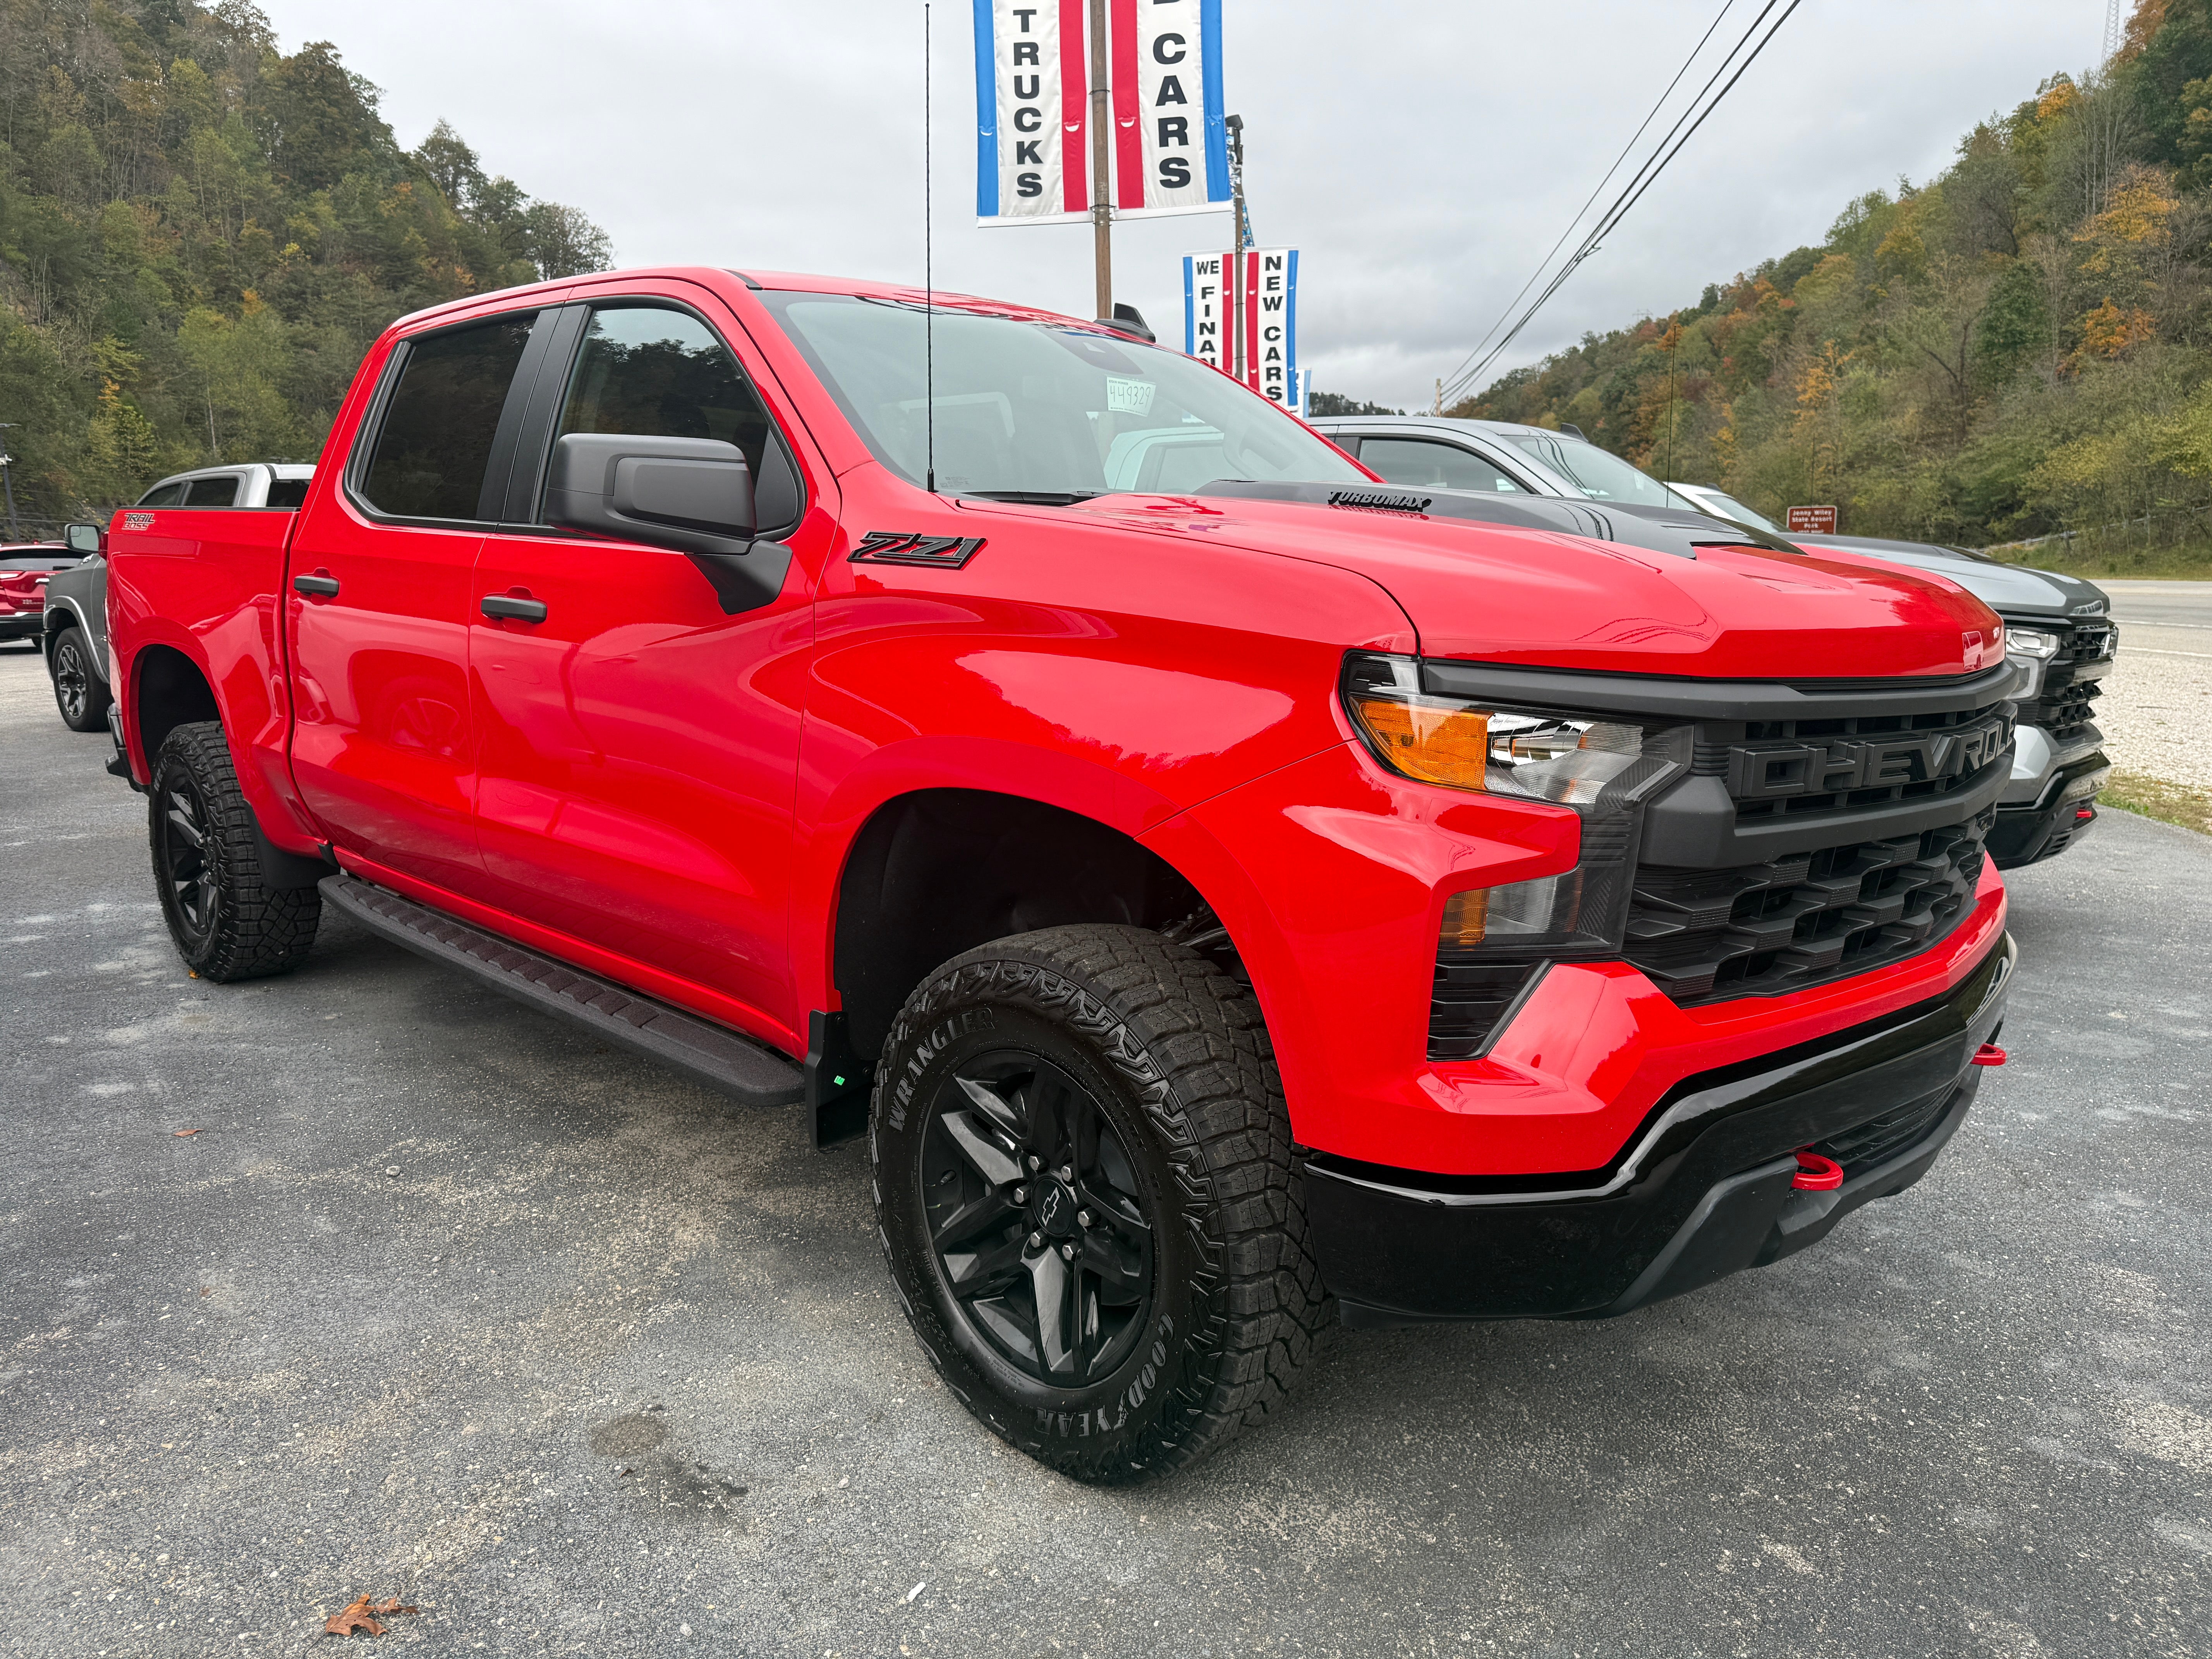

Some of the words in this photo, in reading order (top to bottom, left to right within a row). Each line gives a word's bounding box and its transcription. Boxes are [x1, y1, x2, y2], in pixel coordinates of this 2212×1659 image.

[1013, 9, 1042, 198] TRUCKS
[1152, 33, 1191, 189] CARS
[1196, 260, 1219, 275] WE
[1262, 256, 1283, 311] NEW
[1264, 326, 1282, 401] CARS
[1110, 385, 1151, 409] 449329
[124, 514, 155, 523] TRAIL
[1328, 491, 1432, 512] TURBOMAX
[122, 522, 149, 530] BOSS
[847, 531, 987, 570] Z71
[889, 1007, 996, 1132] WRANGLER
[1034, 1312, 1174, 1437] GOODYEAR
